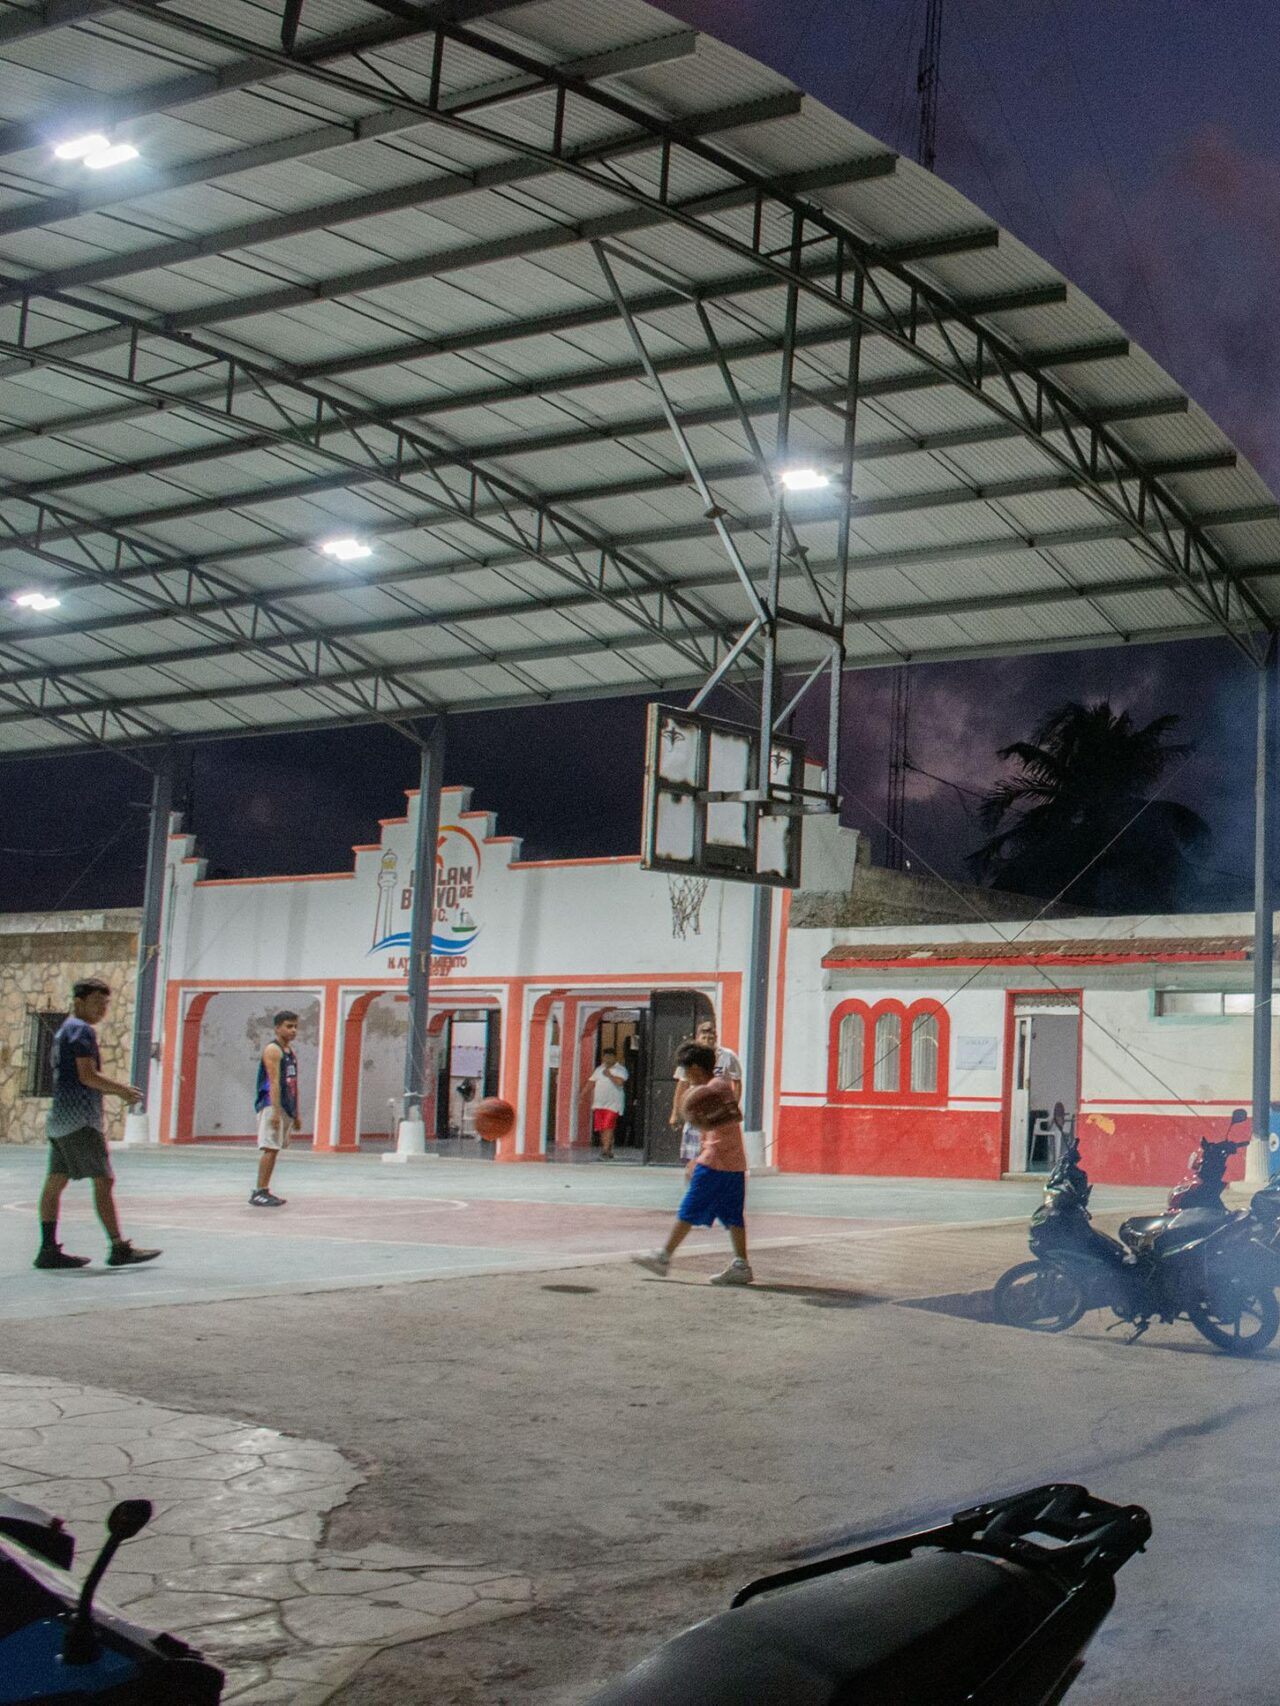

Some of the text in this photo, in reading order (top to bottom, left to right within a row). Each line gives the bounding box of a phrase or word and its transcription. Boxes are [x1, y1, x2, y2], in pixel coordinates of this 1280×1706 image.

[410, 866, 472, 888] LAM
[401, 886, 460, 910] BVO,
[459, 886, 474, 898] DE
